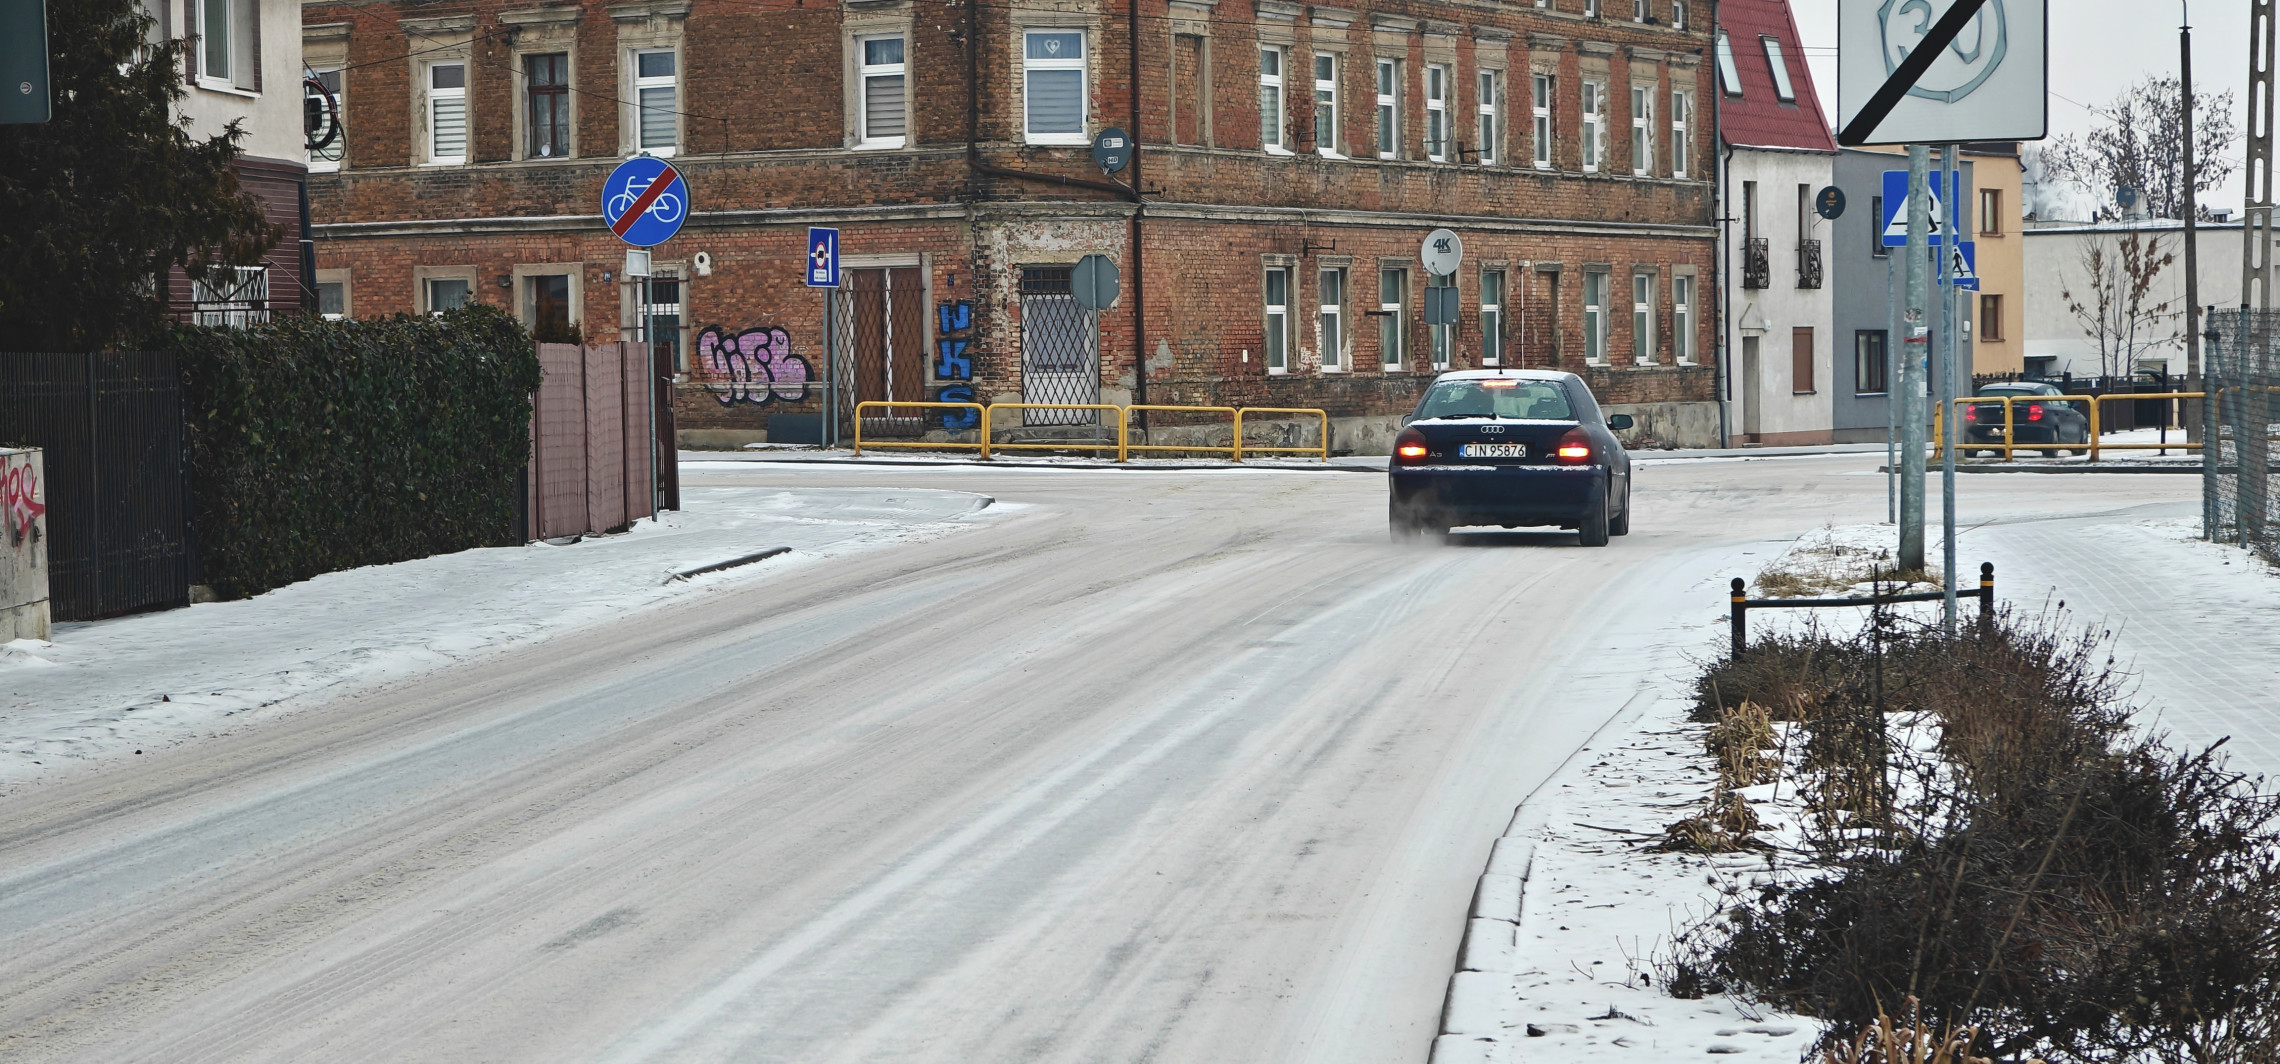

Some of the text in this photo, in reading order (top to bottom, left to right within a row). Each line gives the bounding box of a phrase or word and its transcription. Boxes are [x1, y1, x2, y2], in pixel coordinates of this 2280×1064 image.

[1433, 238, 1451, 249] 4K
[1465, 445, 1487, 457] CIN
[1490, 445, 1525, 457] 95876
